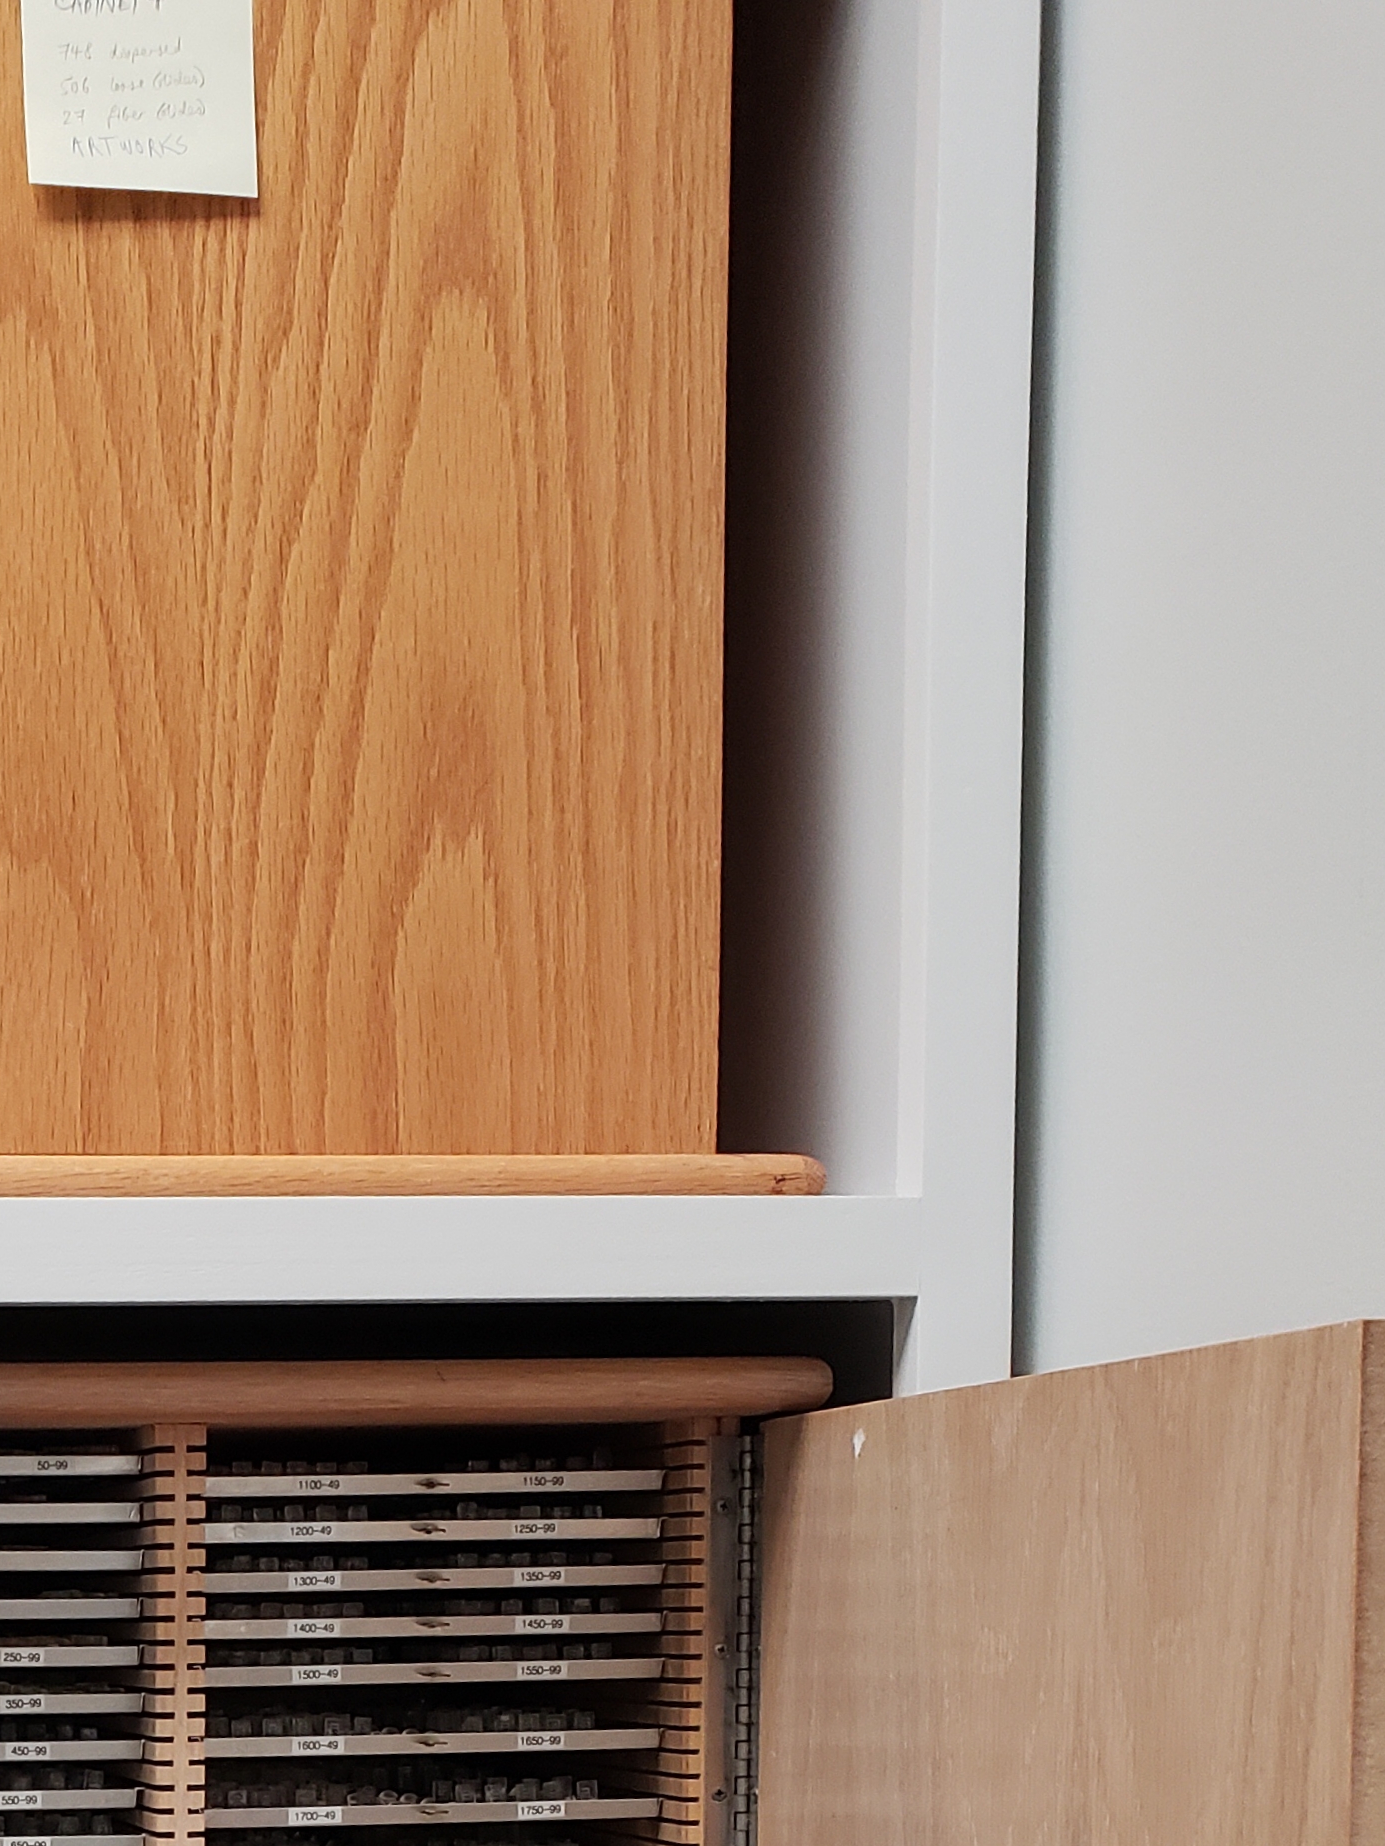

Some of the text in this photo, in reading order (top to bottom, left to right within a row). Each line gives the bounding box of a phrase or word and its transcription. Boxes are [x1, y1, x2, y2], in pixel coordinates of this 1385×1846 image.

[37, 1461, 68, 1470] 50-99
[298, 1477, 564, 1490] 1100-49 1150-99
[514, 1524, 556, 1534] 1250-99
[294, 1571, 561, 1586] 1300-49 1350-99
[293, 1619, 563, 1633] 1400-49 1450-99
[3, 1652, 40, 1662] 250-99
[297, 1665, 561, 1679] 1500-49 1550-99
[5, 1698, 42, 1709] 350-99
[297, 1735, 561, 1751] 1600-49 1650-99
[11, 1746, 47, 1756] 450-99
[1, 1795, 38, 1805] 550-99
[295, 1804, 561, 1821] 1700-49 1750-99
